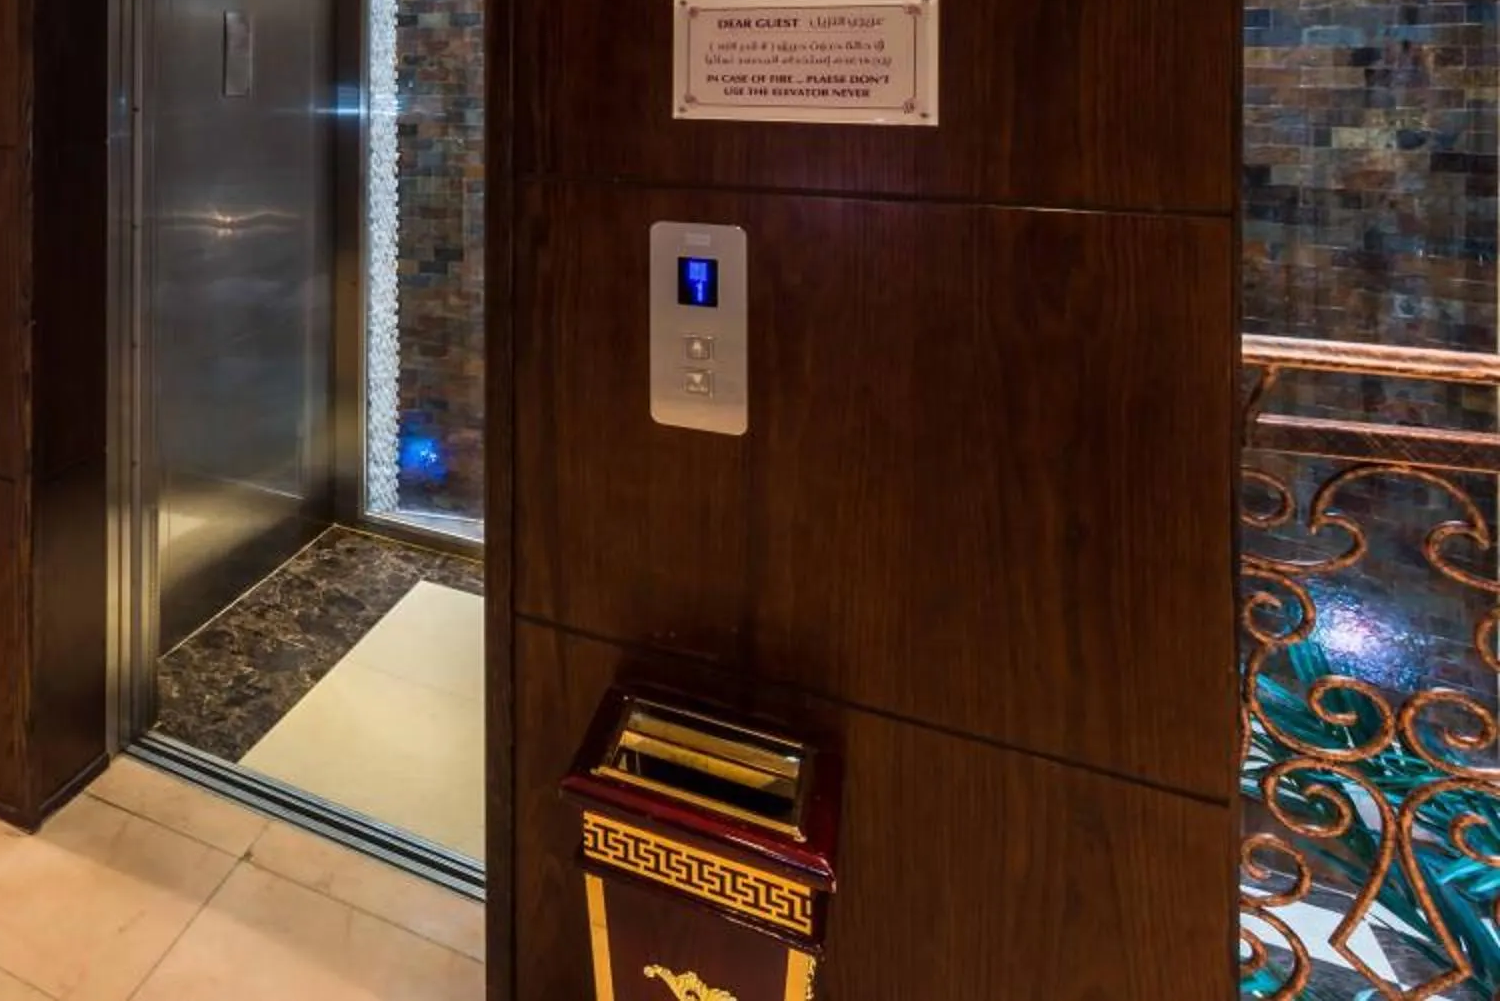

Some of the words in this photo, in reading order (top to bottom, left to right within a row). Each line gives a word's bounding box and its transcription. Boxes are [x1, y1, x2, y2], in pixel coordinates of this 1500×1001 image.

[717, 18, 752, 29] DEAR
[755, 17, 800, 29] GUEST
[706, 74, 719, 83] IN
[721, 74, 748, 83] CASE
[751, 74, 766, 84] OF
[769, 74, 793, 84] FIRE
[723, 86, 744, 96] USE
[747, 87, 768, 97] THE
[771, 87, 829, 98] ELEVATOR
[831, 88, 871, 98] NEVER
